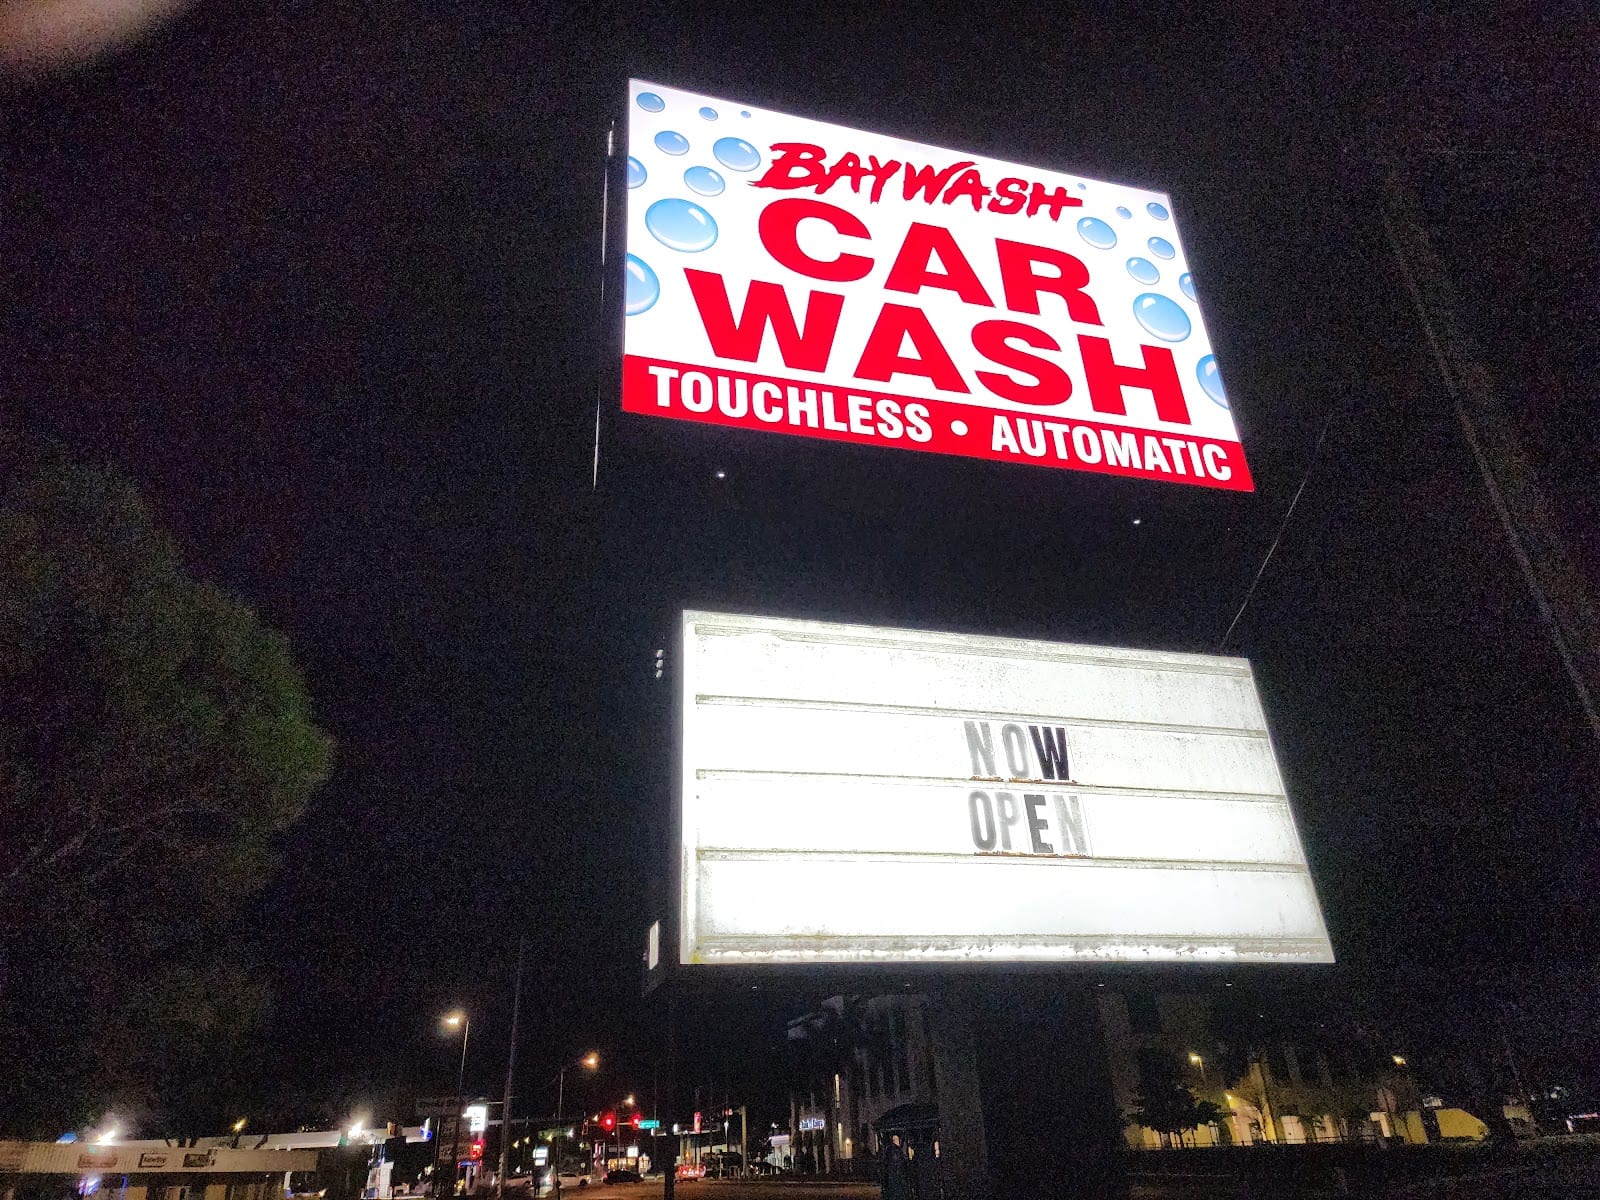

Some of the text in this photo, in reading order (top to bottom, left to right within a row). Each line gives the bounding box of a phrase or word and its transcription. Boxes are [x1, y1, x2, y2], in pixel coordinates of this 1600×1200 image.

[747, 142, 1083, 222] BAYWASH
[758, 197, 1105, 327] CAR
[683, 267, 1192, 426] WASH
[648, 365, 1232, 482] TOUCHLESS AUTOMATIC
[964, 720, 1070, 780] NOW
[968, 790, 1087, 853] OPEN
